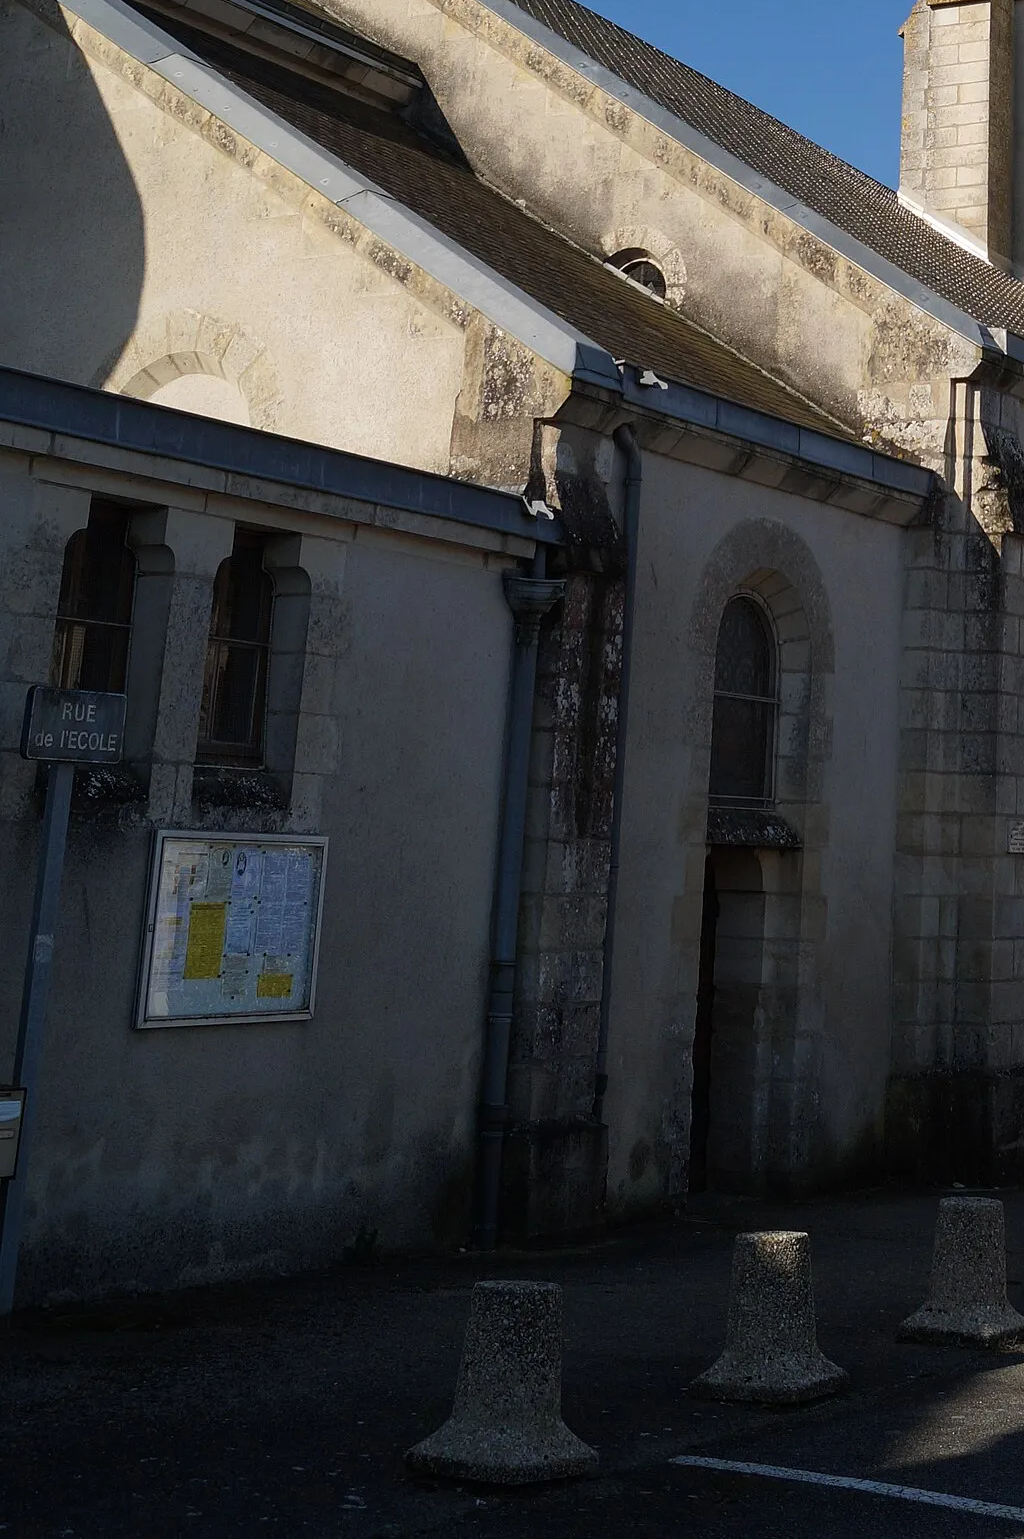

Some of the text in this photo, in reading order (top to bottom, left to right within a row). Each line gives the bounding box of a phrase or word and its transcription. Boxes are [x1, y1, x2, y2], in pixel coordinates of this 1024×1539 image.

[62, 702, 97, 723] RUE
[35, 729, 118, 752] de l'ECOLE
